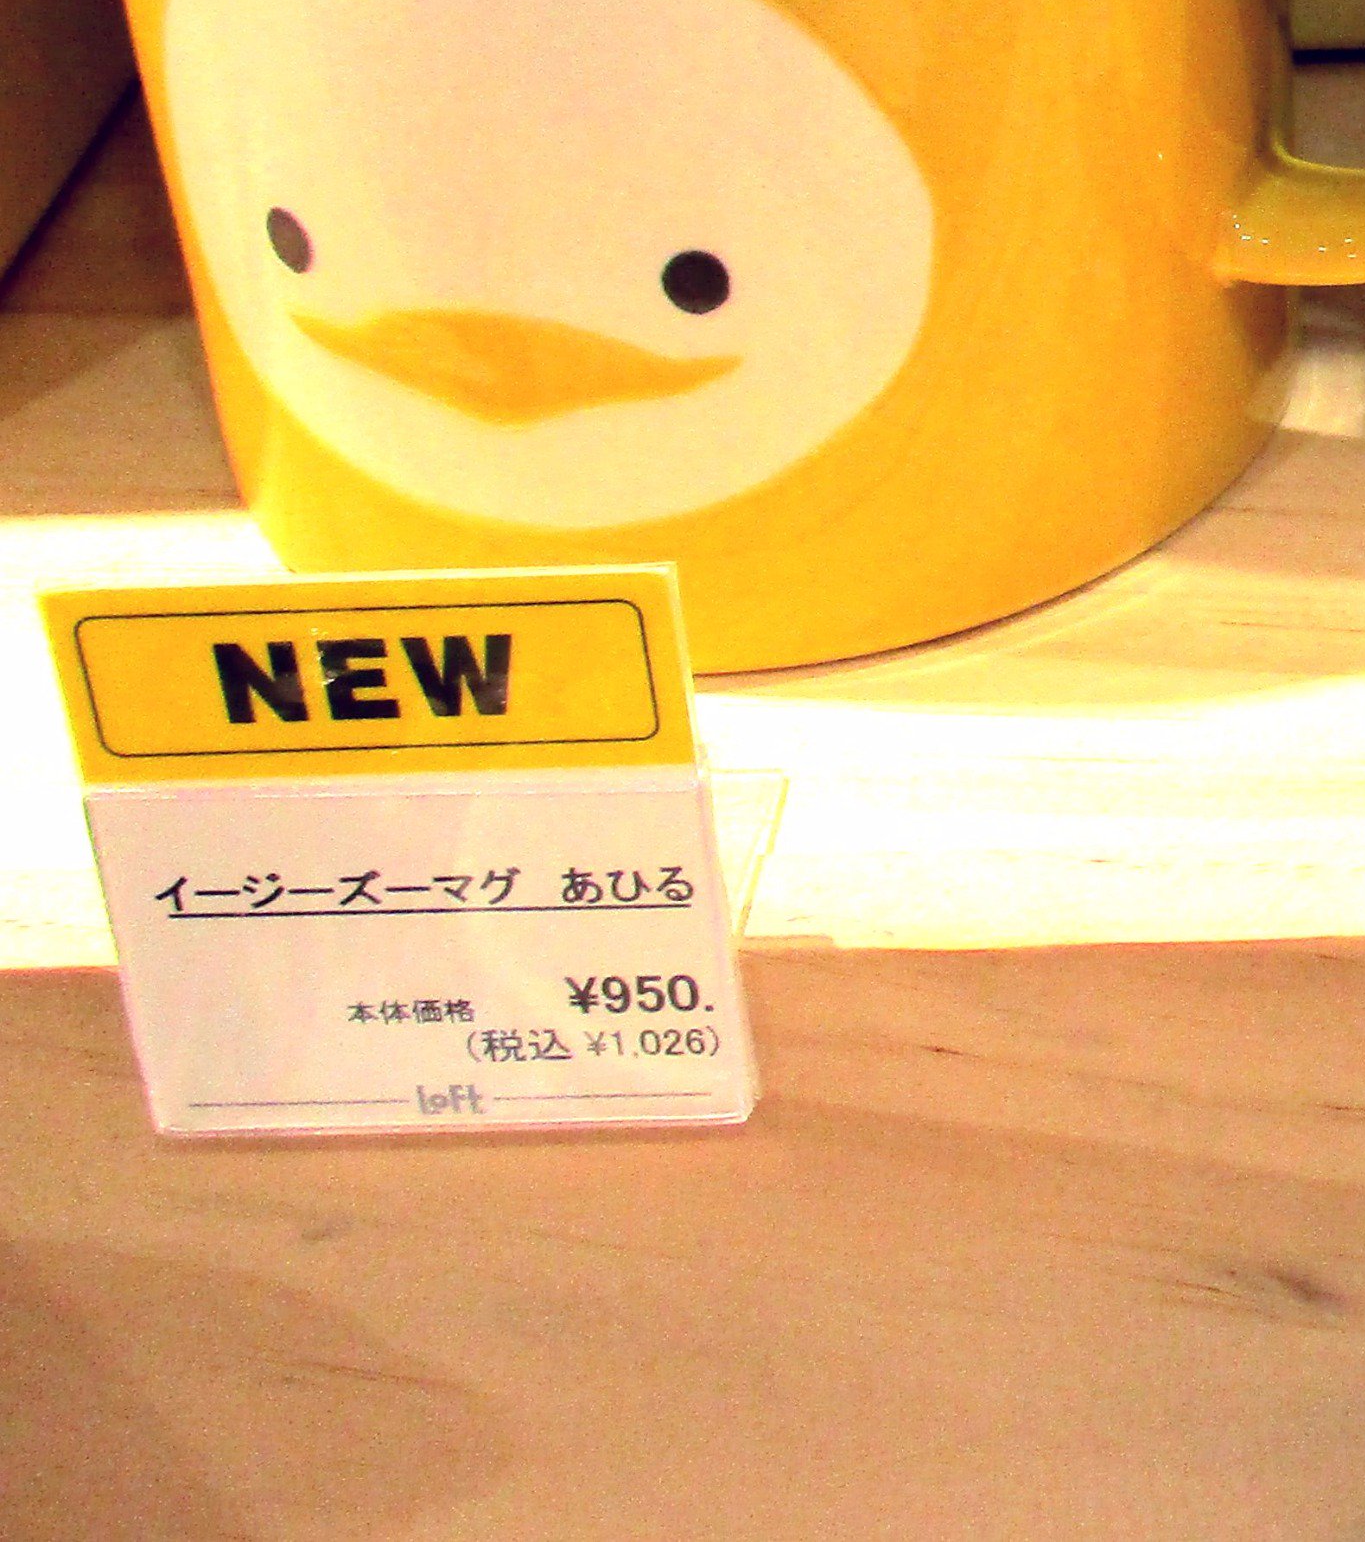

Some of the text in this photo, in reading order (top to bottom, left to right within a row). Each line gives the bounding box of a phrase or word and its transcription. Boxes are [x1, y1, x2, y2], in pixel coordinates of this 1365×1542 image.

[212, 634, 513, 724] NEW
[154, 866, 696, 911] イージーズーマグ あひる
[348, 999, 476, 1024] 本体価格
